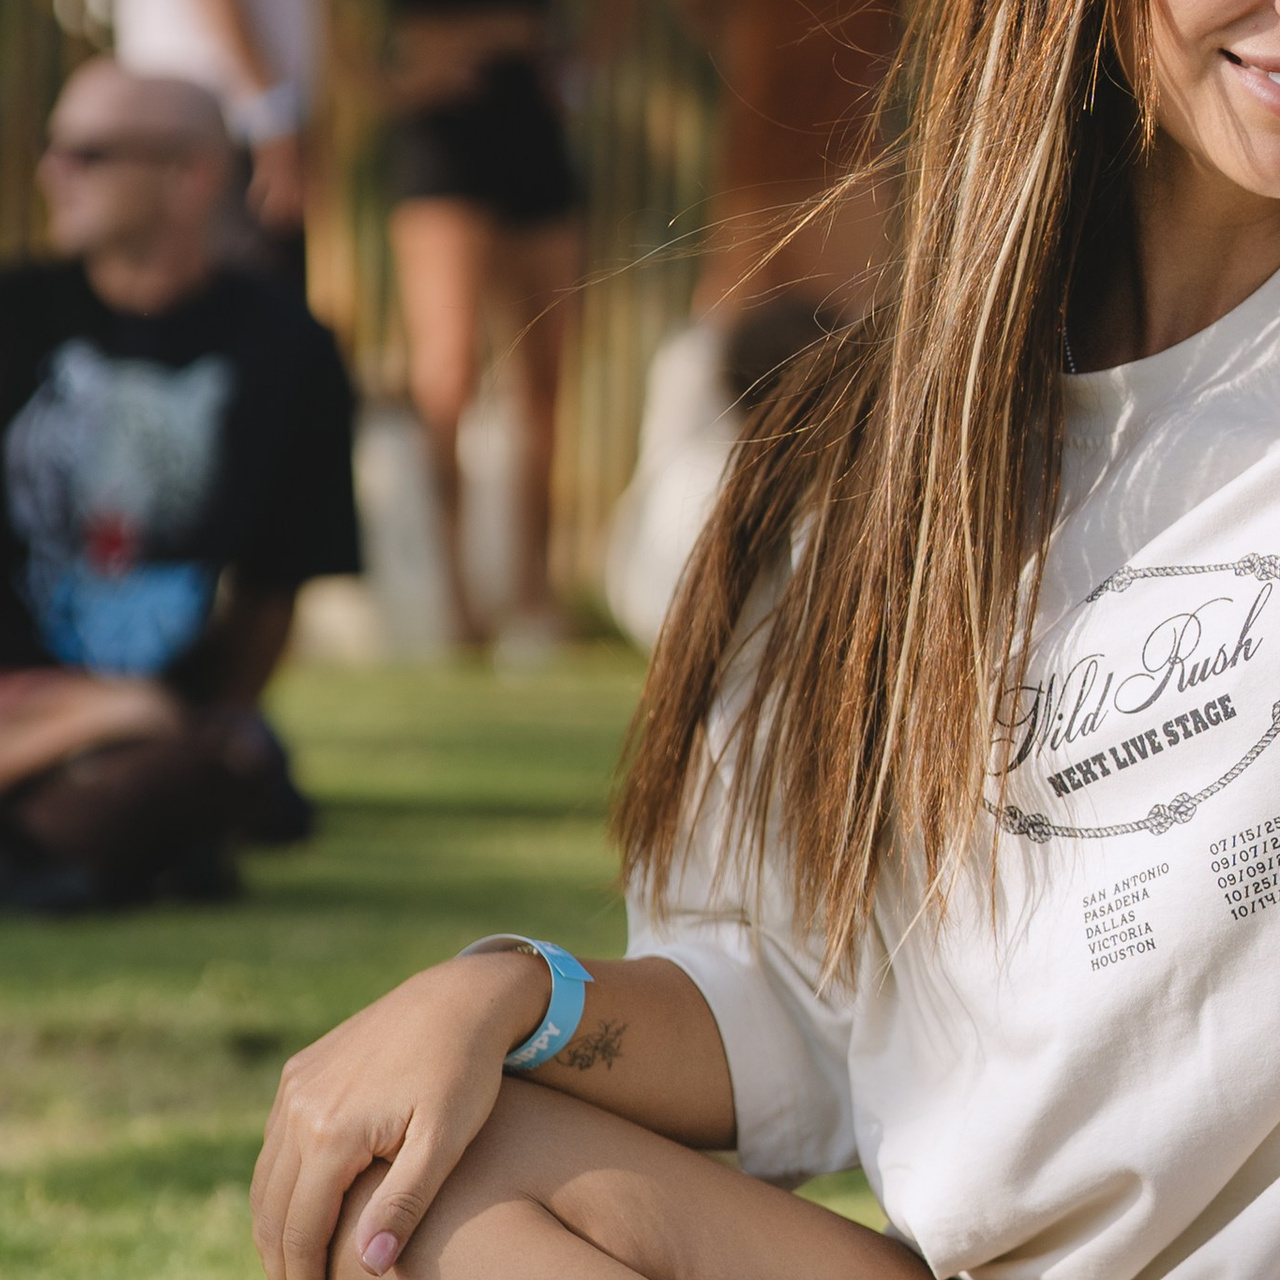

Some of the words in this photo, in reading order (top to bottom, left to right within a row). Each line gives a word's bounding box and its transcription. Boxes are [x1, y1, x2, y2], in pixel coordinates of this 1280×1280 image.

[987, 654, 1114, 777] Wild
[1114, 583, 1273, 714] Rush
[1047, 752, 1111, 798] NEXT
[1109, 728, 1163, 771] LIVE
[1165, 694, 1238, 747] STAGE
[1082, 891, 1106, 908] SAN
[1113, 862, 1170, 896] ANTONIO
[1084, 888, 1150, 923] PASADENA
[1086, 910, 1136, 939] DALLAS
[1088, 922, 1153, 955] VICTORIA
[1090, 938, 1157, 971] HOUSTON
